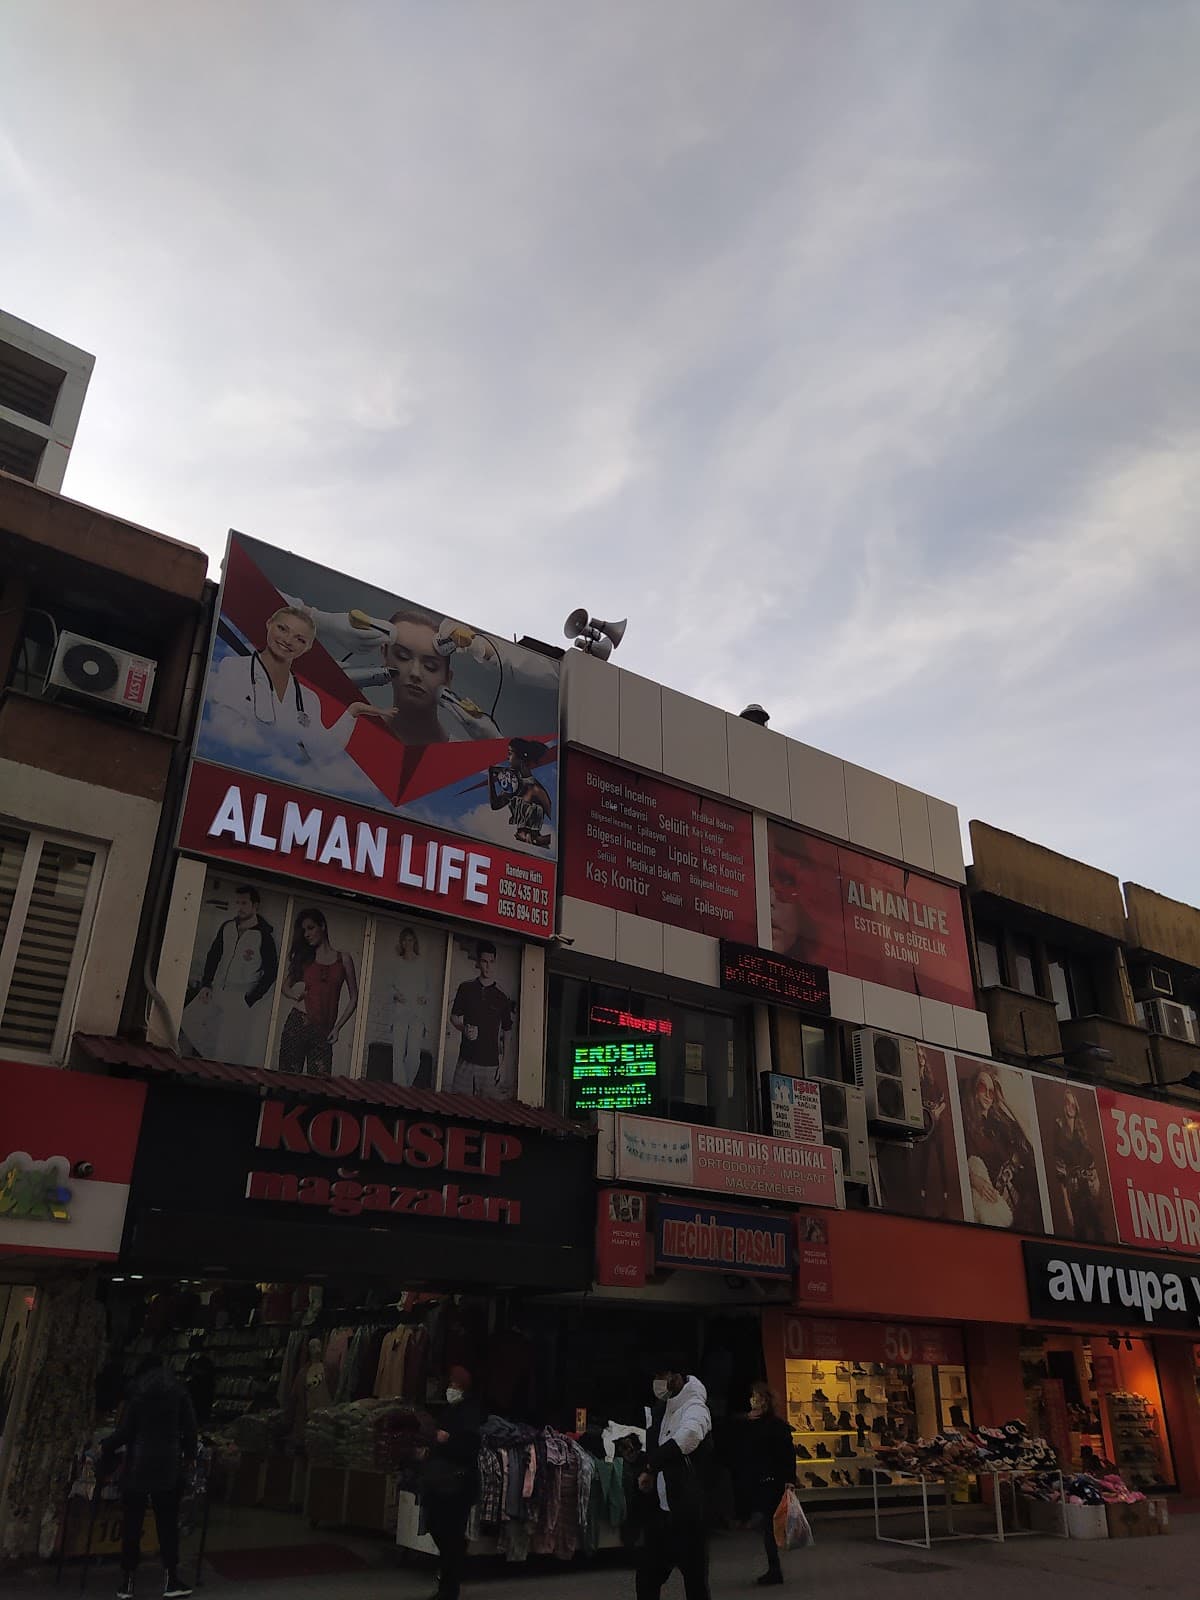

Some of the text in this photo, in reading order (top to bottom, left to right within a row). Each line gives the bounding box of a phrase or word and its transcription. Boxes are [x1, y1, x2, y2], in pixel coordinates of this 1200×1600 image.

[587, 771, 623, 797] Bölgesel
[587, 823, 622, 847] Bölgesel
[659, 814, 690, 838] Selülit
[207, 785, 491, 906] ALMAN LIFE
[669, 845, 699, 868] Lipoliz
[586, 861, 651, 896] Kaş Kontör
[626, 855, 656, 876] Medikal
[499, 878, 549, 906] 0362 435 10 13
[848, 879, 950, 935] ALMAN LIFE
[498, 898, 516, 918] 0553
[531, 907, 541, 924] 05
[541, 910, 549, 927] 13
[694, 897, 735, 921] Epilasyon
[854, 915, 892, 940] ESTETİK
[894, 932, 905, 944] ve
[884, 942, 920, 966] SALONU
[575, 1043, 654, 1063] ERDEM
[255, 1099, 523, 1177] KONSEP
[697, 1133, 827, 1170] ERDEM DİŞ MEDİKAL
[1111, 1108, 1163, 1165] 365
[245, 1167, 522, 1225] mağazaları
[1127, 1178, 1200, 1247] İNDİR
[662, 1213, 786, 1269] MECİDİYE PASAJI
[1047, 1259, 1188, 1322] avrupa
[884, 1327, 913, 1360] 50
